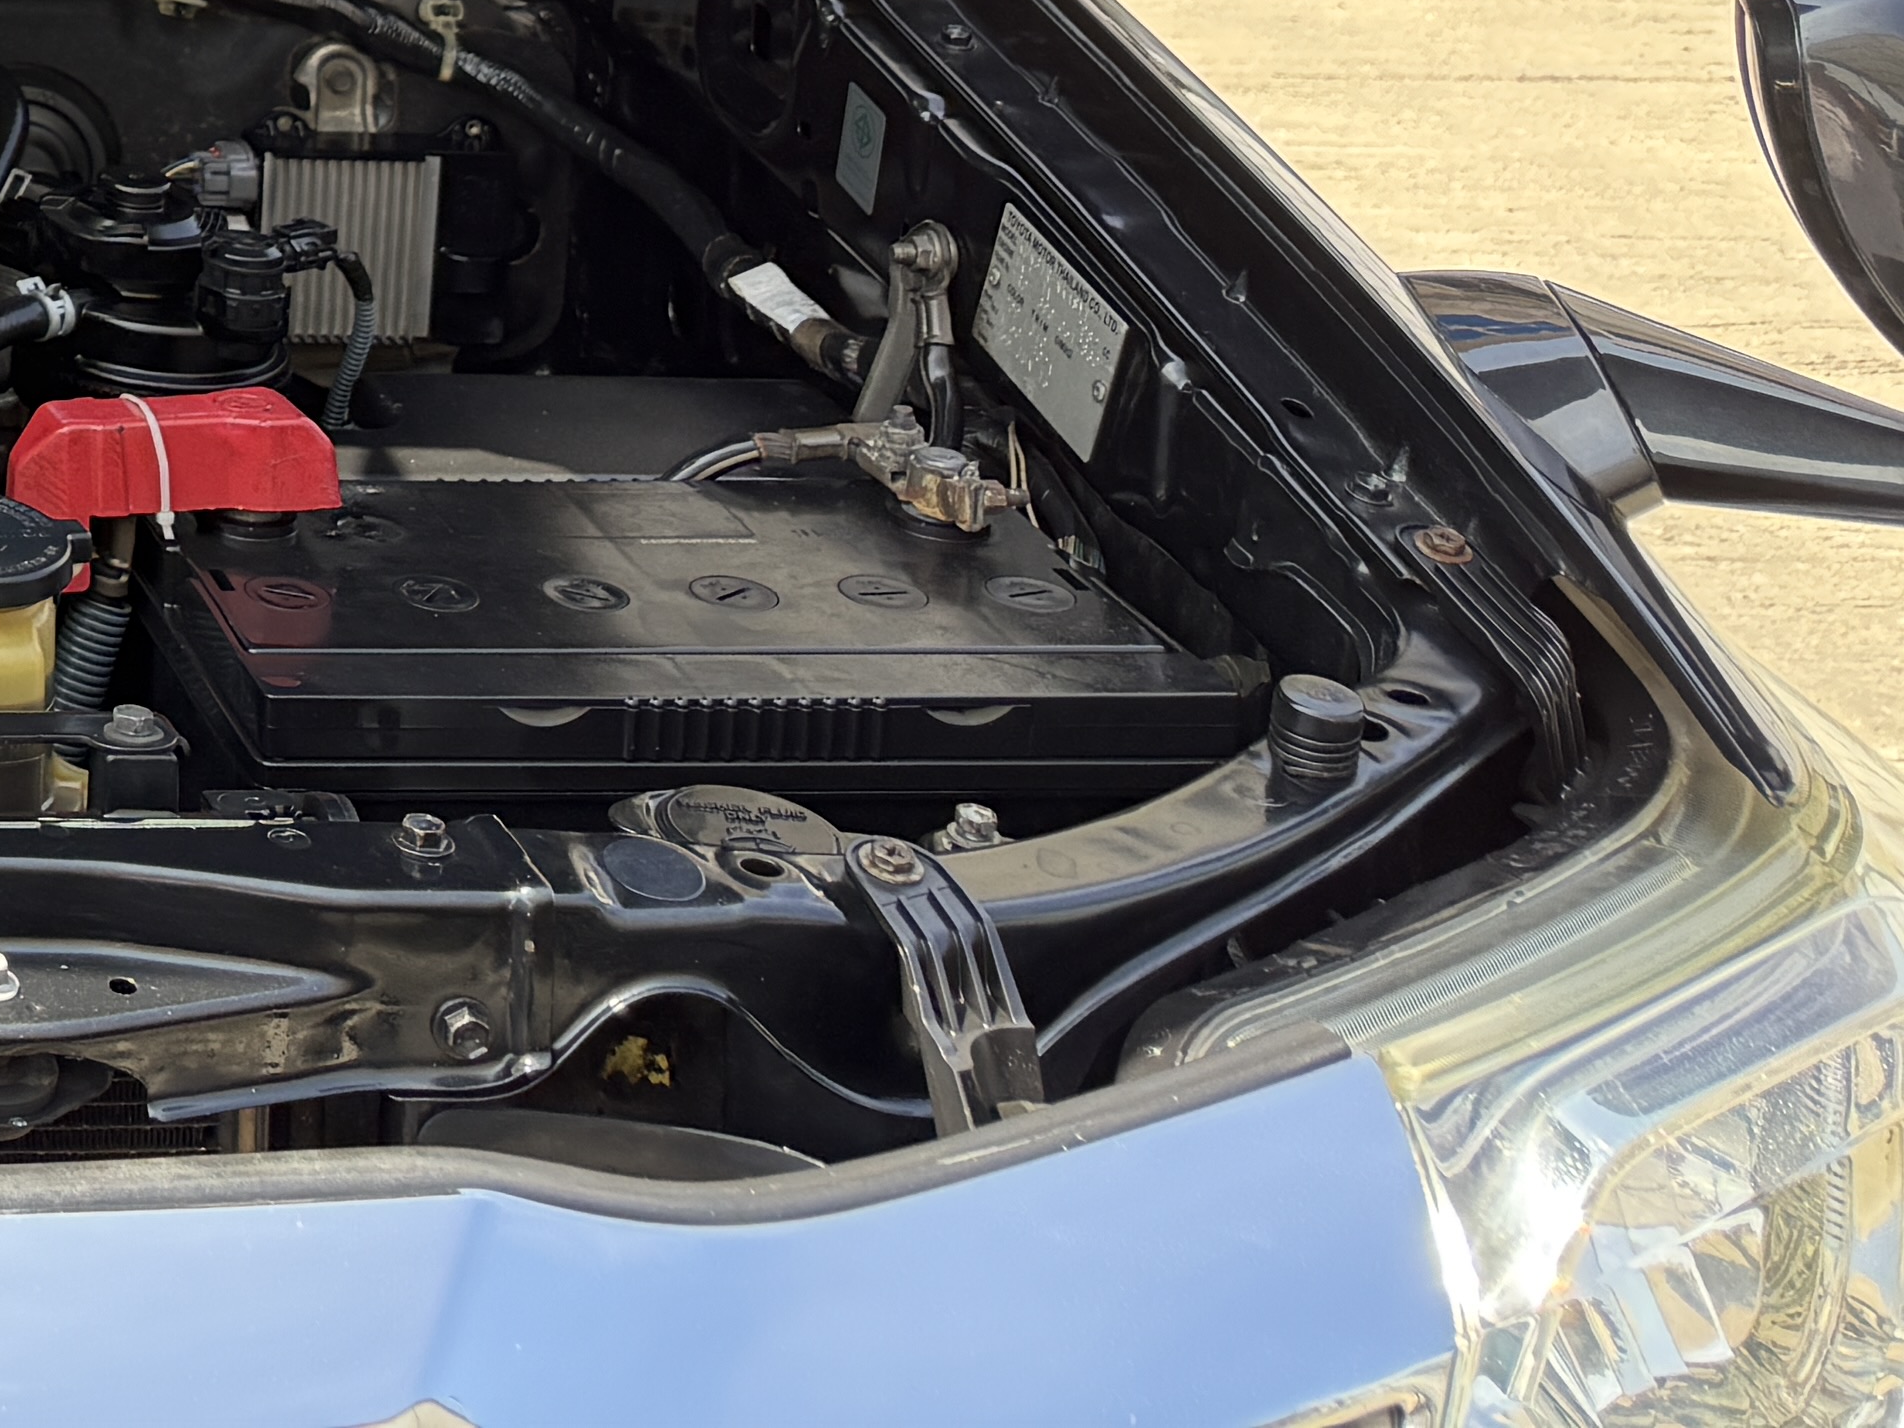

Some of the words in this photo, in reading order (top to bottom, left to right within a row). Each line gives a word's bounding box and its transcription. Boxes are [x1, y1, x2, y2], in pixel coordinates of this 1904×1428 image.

[1008, 210, 1034, 245] TOYOTA
[1033, 238, 1056, 268] MOTOR
[1054, 260, 1089, 303] THAILAND
[1103, 313, 1120, 336] LTD.
